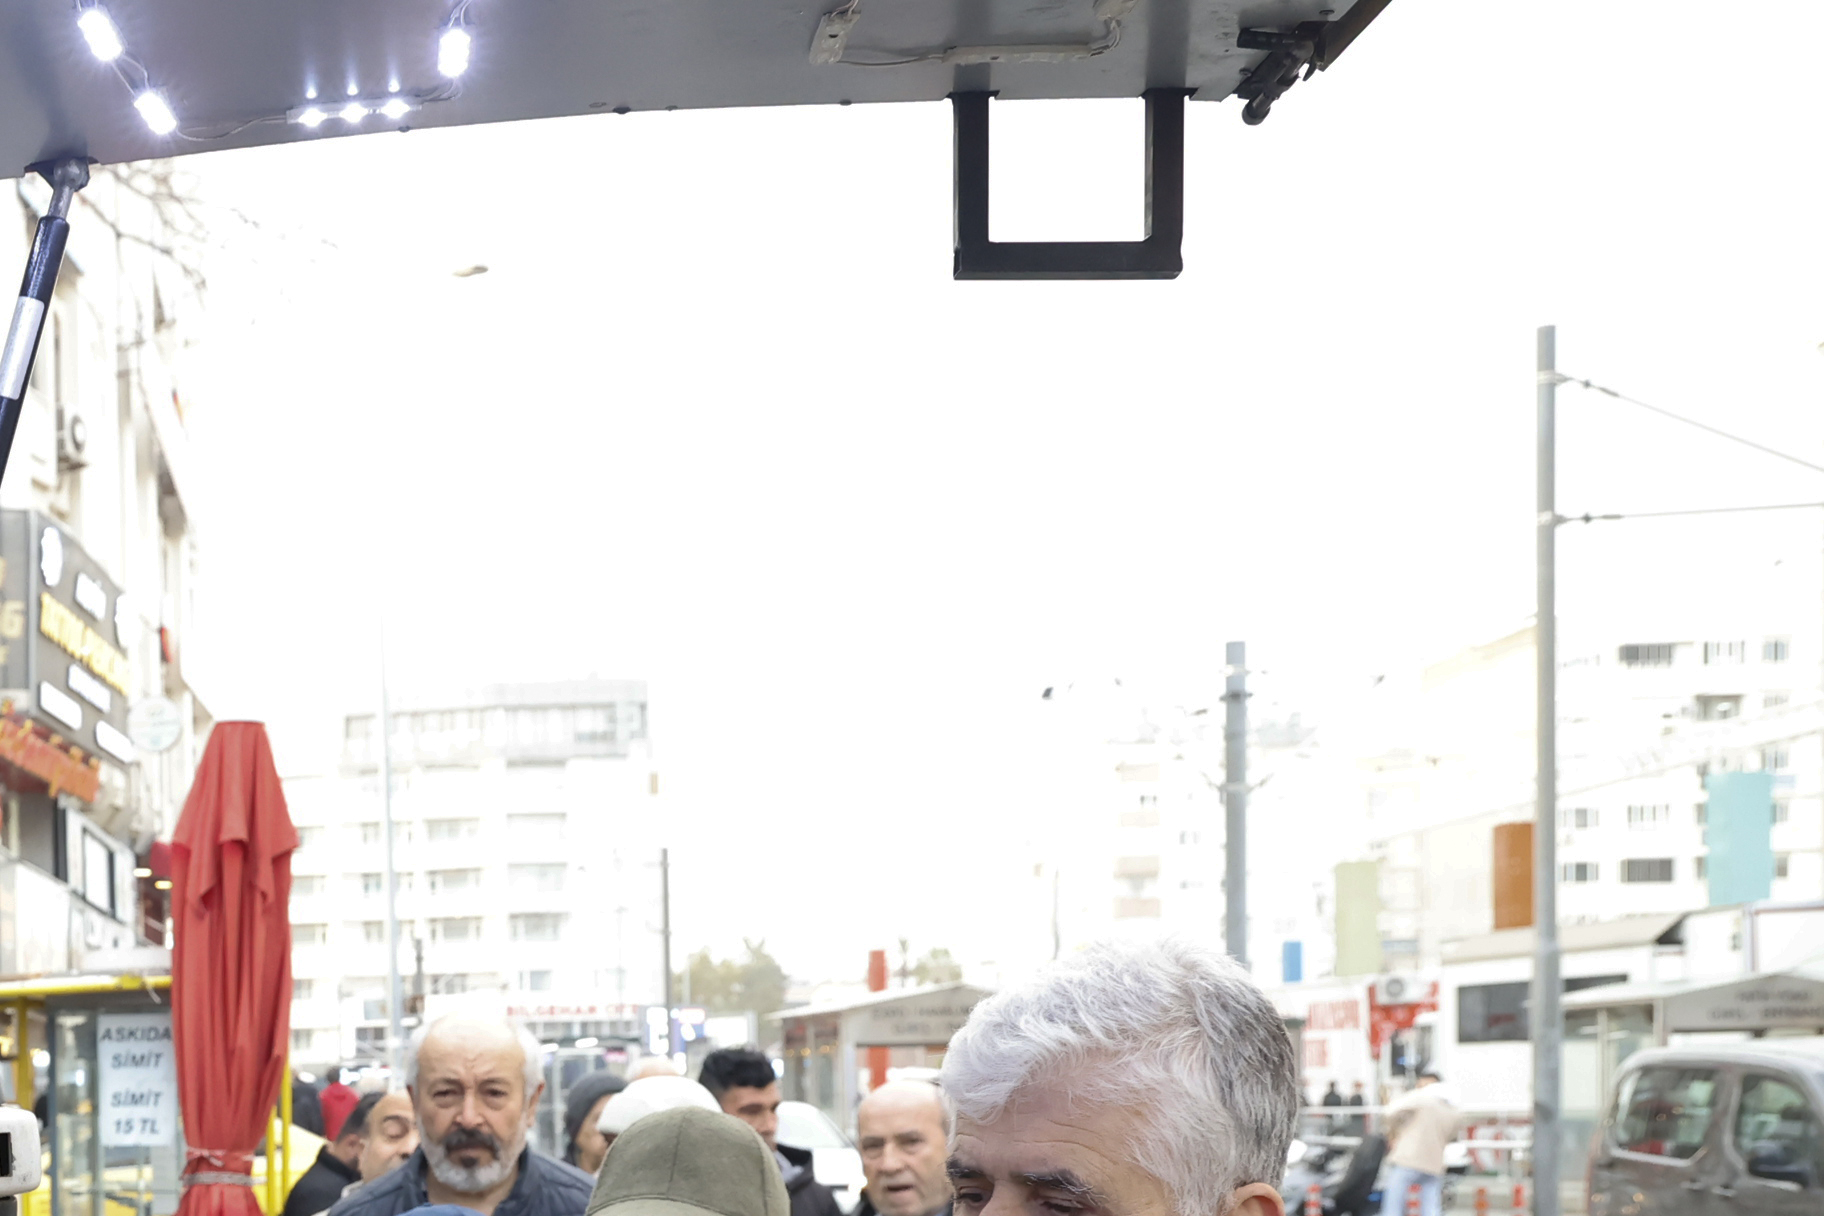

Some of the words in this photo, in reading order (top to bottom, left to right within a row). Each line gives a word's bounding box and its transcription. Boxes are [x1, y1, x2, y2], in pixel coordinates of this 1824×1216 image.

[100, 1026, 172, 1041] ASKIDA
[111, 1049, 164, 1070] SİMİT
[111, 1087, 164, 1108] SİMİT
[114, 1118, 134, 1134] 15
[139, 1118, 160, 1134] TL
